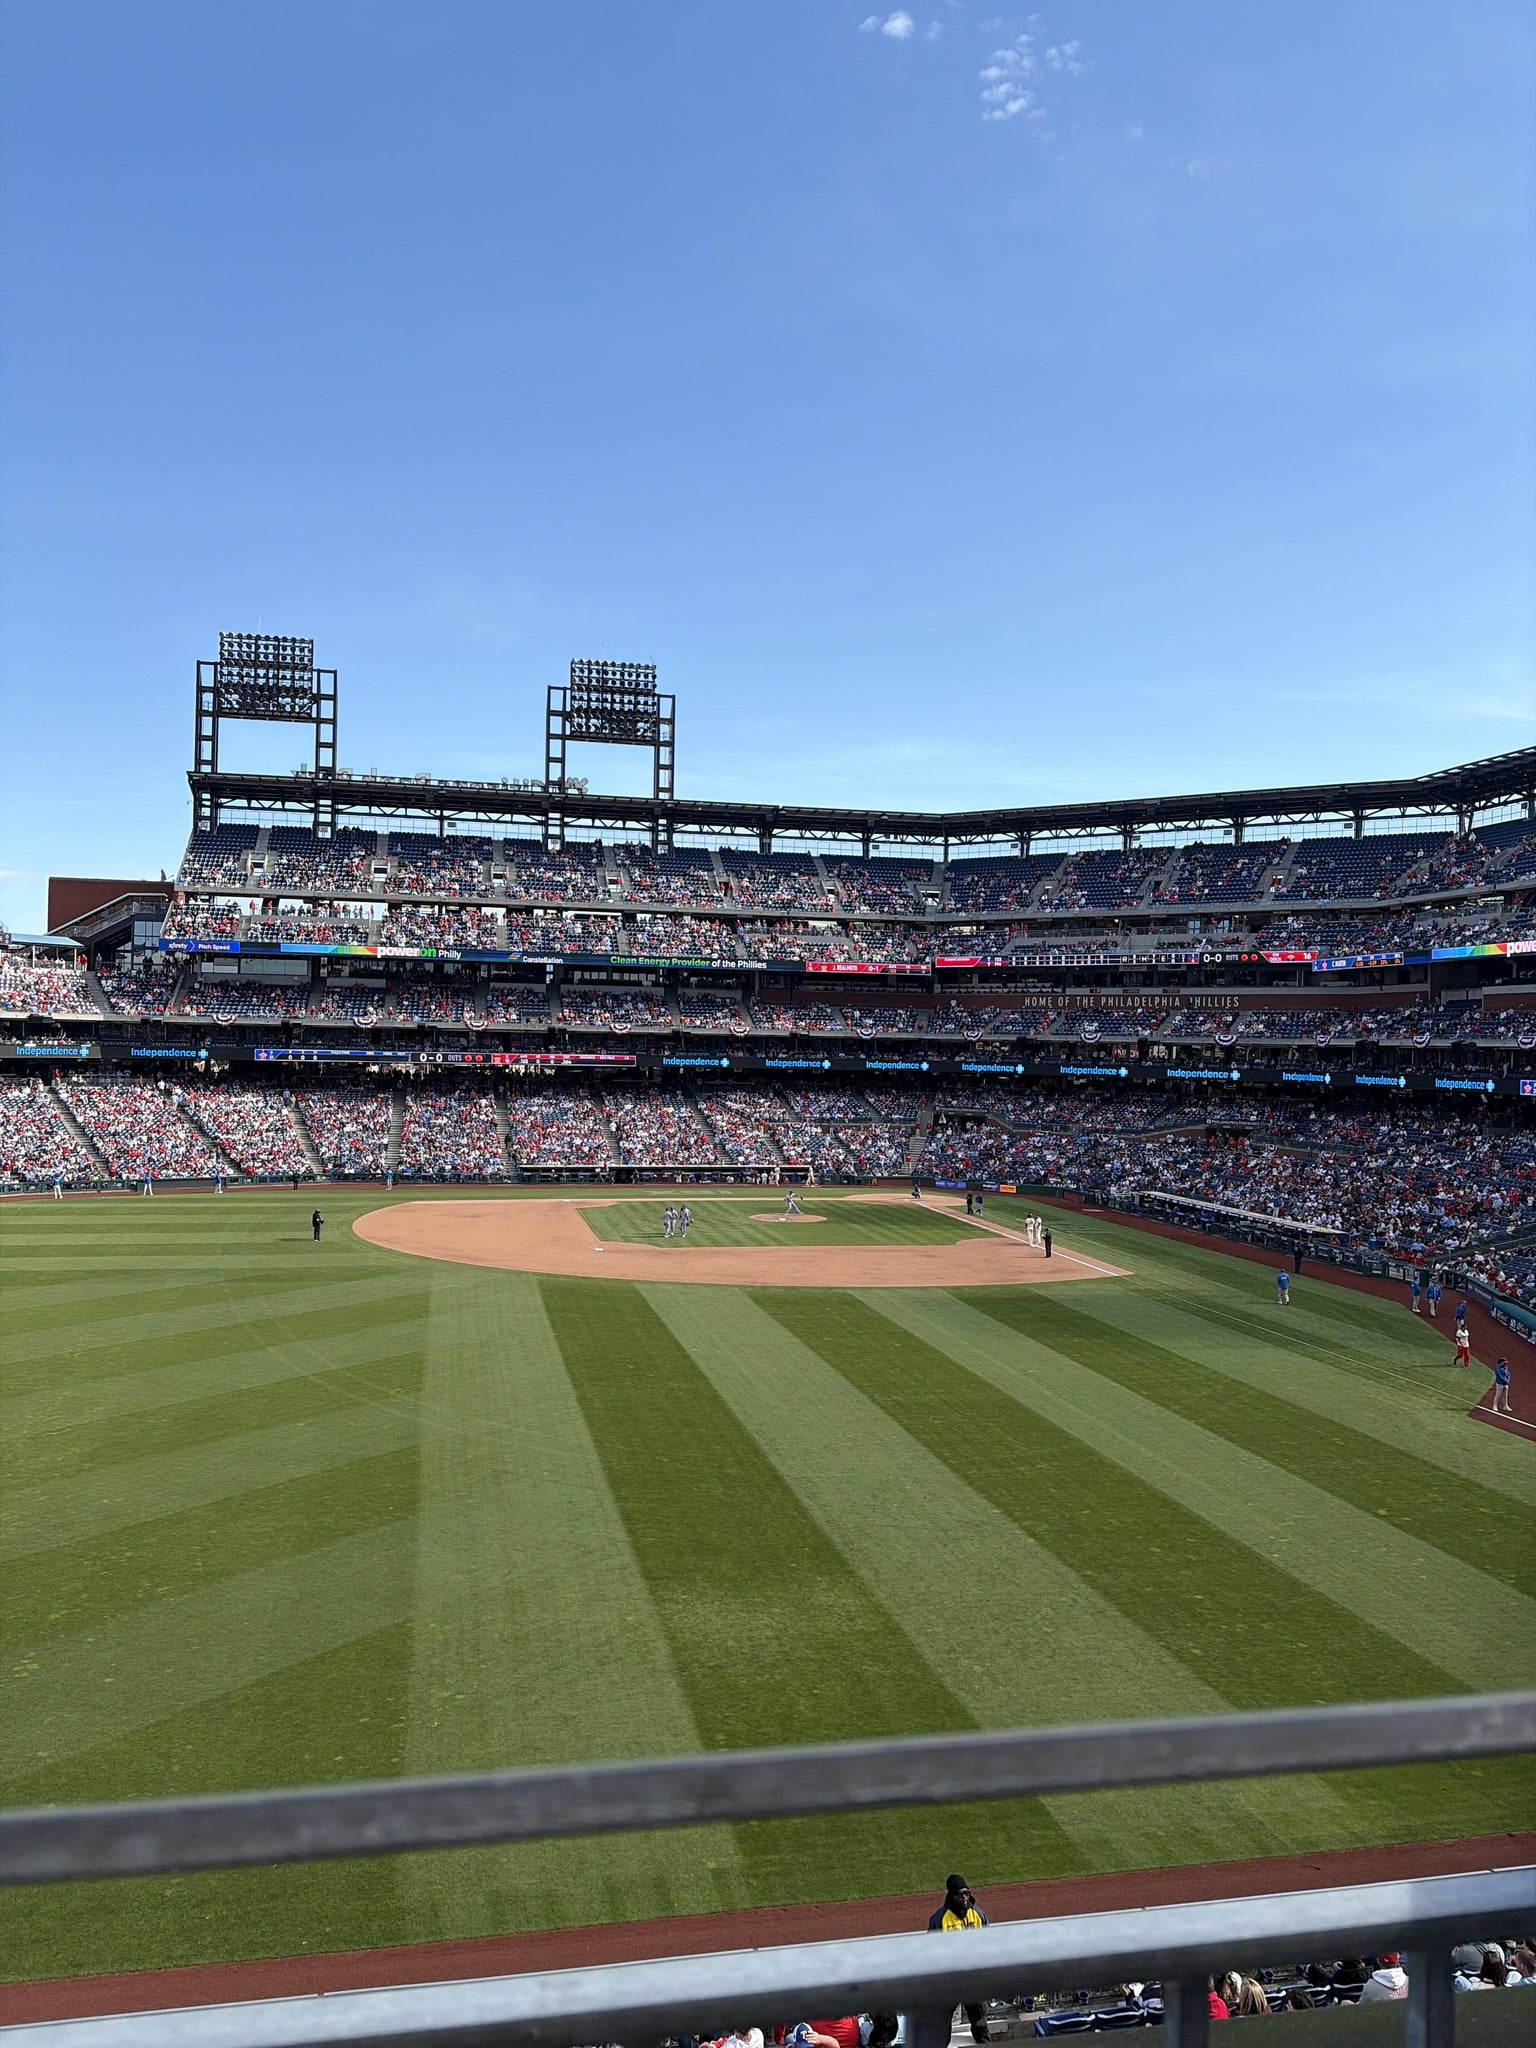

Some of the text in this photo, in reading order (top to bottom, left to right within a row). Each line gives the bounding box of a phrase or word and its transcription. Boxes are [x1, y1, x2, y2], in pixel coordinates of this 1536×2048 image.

[168, 942, 188, 950] xfinity
[438, 949, 462, 960] Philly
[522, 956, 564, 964] Constellation
[1303, 952, 1312, 960] 16
[610, 955, 767, 969] Clean Energy Provider of the Phillies
[1025, 996, 1053, 1006] HOME
[1058, 996, 1070, 1006] OF
[1076, 996, 1095, 1007] THE
[1101, 996, 1180, 1007] PHILADELPHIA
[16, 1046, 78, 1057] Independence
[131, 1047, 196, 1058] Independence
[448, 1054, 462, 1062] OUTS
[663, 1057, 719, 1067] Independence
[766, 1058, 821, 1069] Independence
[866, 1060, 919, 1071] Independence
[962, 1063, 1014, 1073] Independence
[1060, 1065, 1117, 1076] Independence
[1167, 1068, 1229, 1079] Independence
[1283, 1072, 1324, 1083] Independence
[1355, 1074, 1398, 1087] Independence
[1435, 1078, 1485, 1091] Independence
